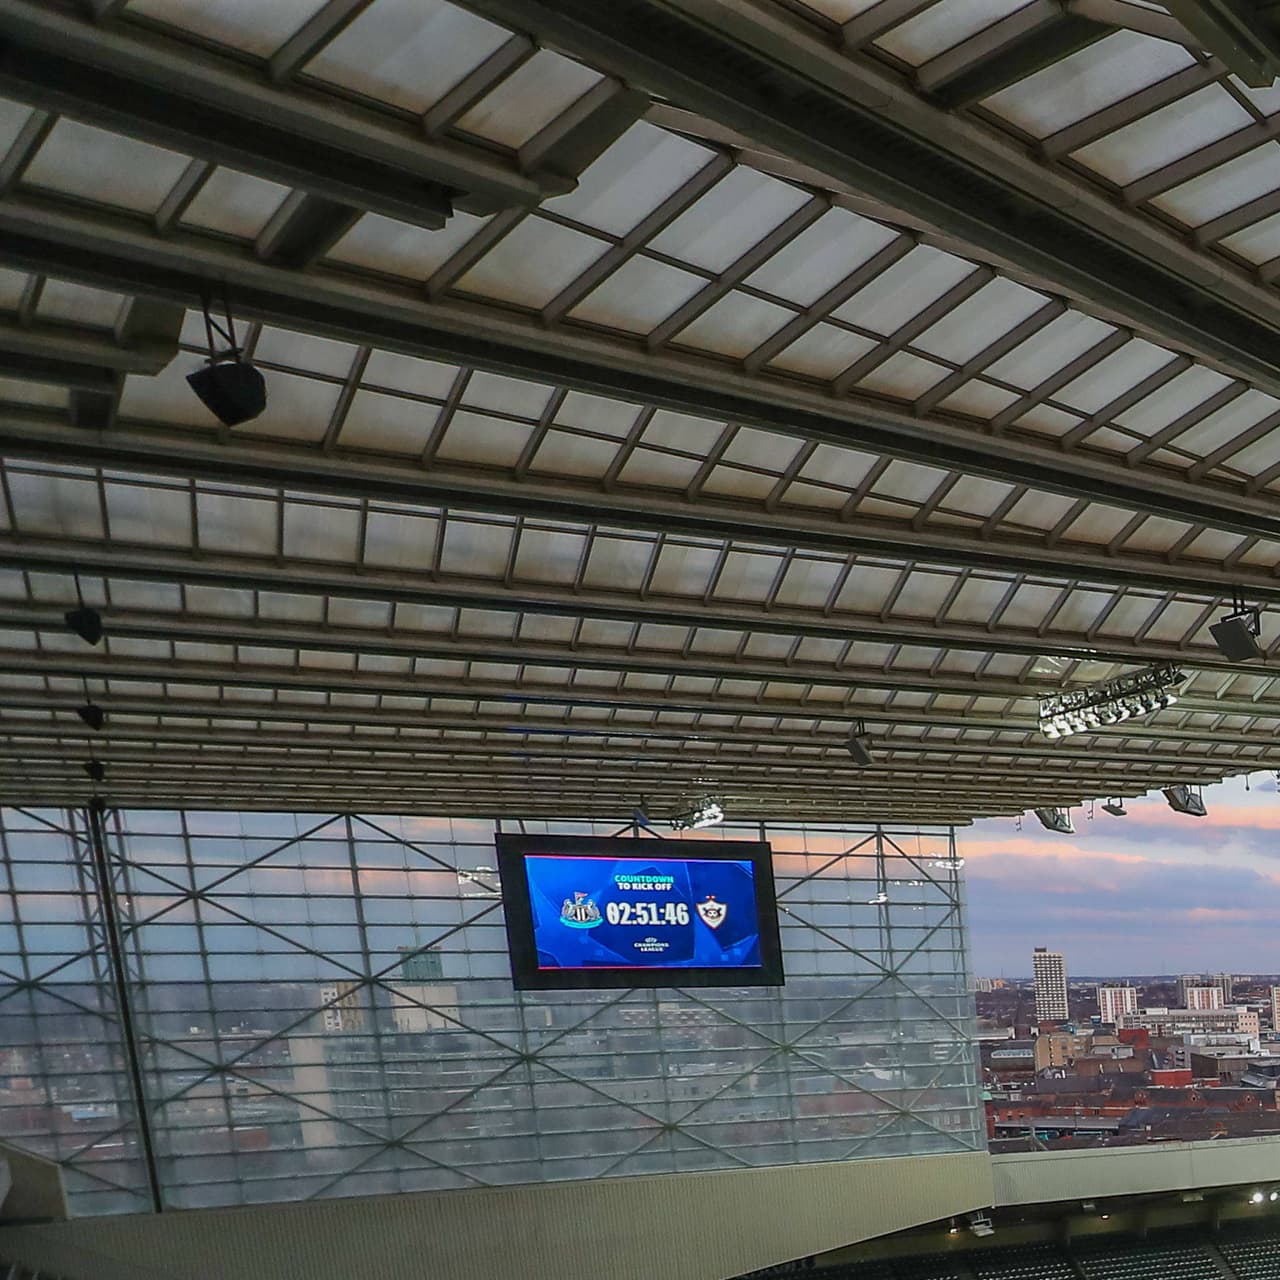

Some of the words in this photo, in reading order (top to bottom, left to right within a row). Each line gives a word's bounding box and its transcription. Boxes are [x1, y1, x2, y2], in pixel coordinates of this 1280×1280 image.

[614, 874, 674, 883] COUNTDOWN
[617, 882, 631, 890] TO
[632, 883, 654, 891] KICK
[654, 883, 673, 891] OFF
[606, 902, 690, 926] 02:51:46
